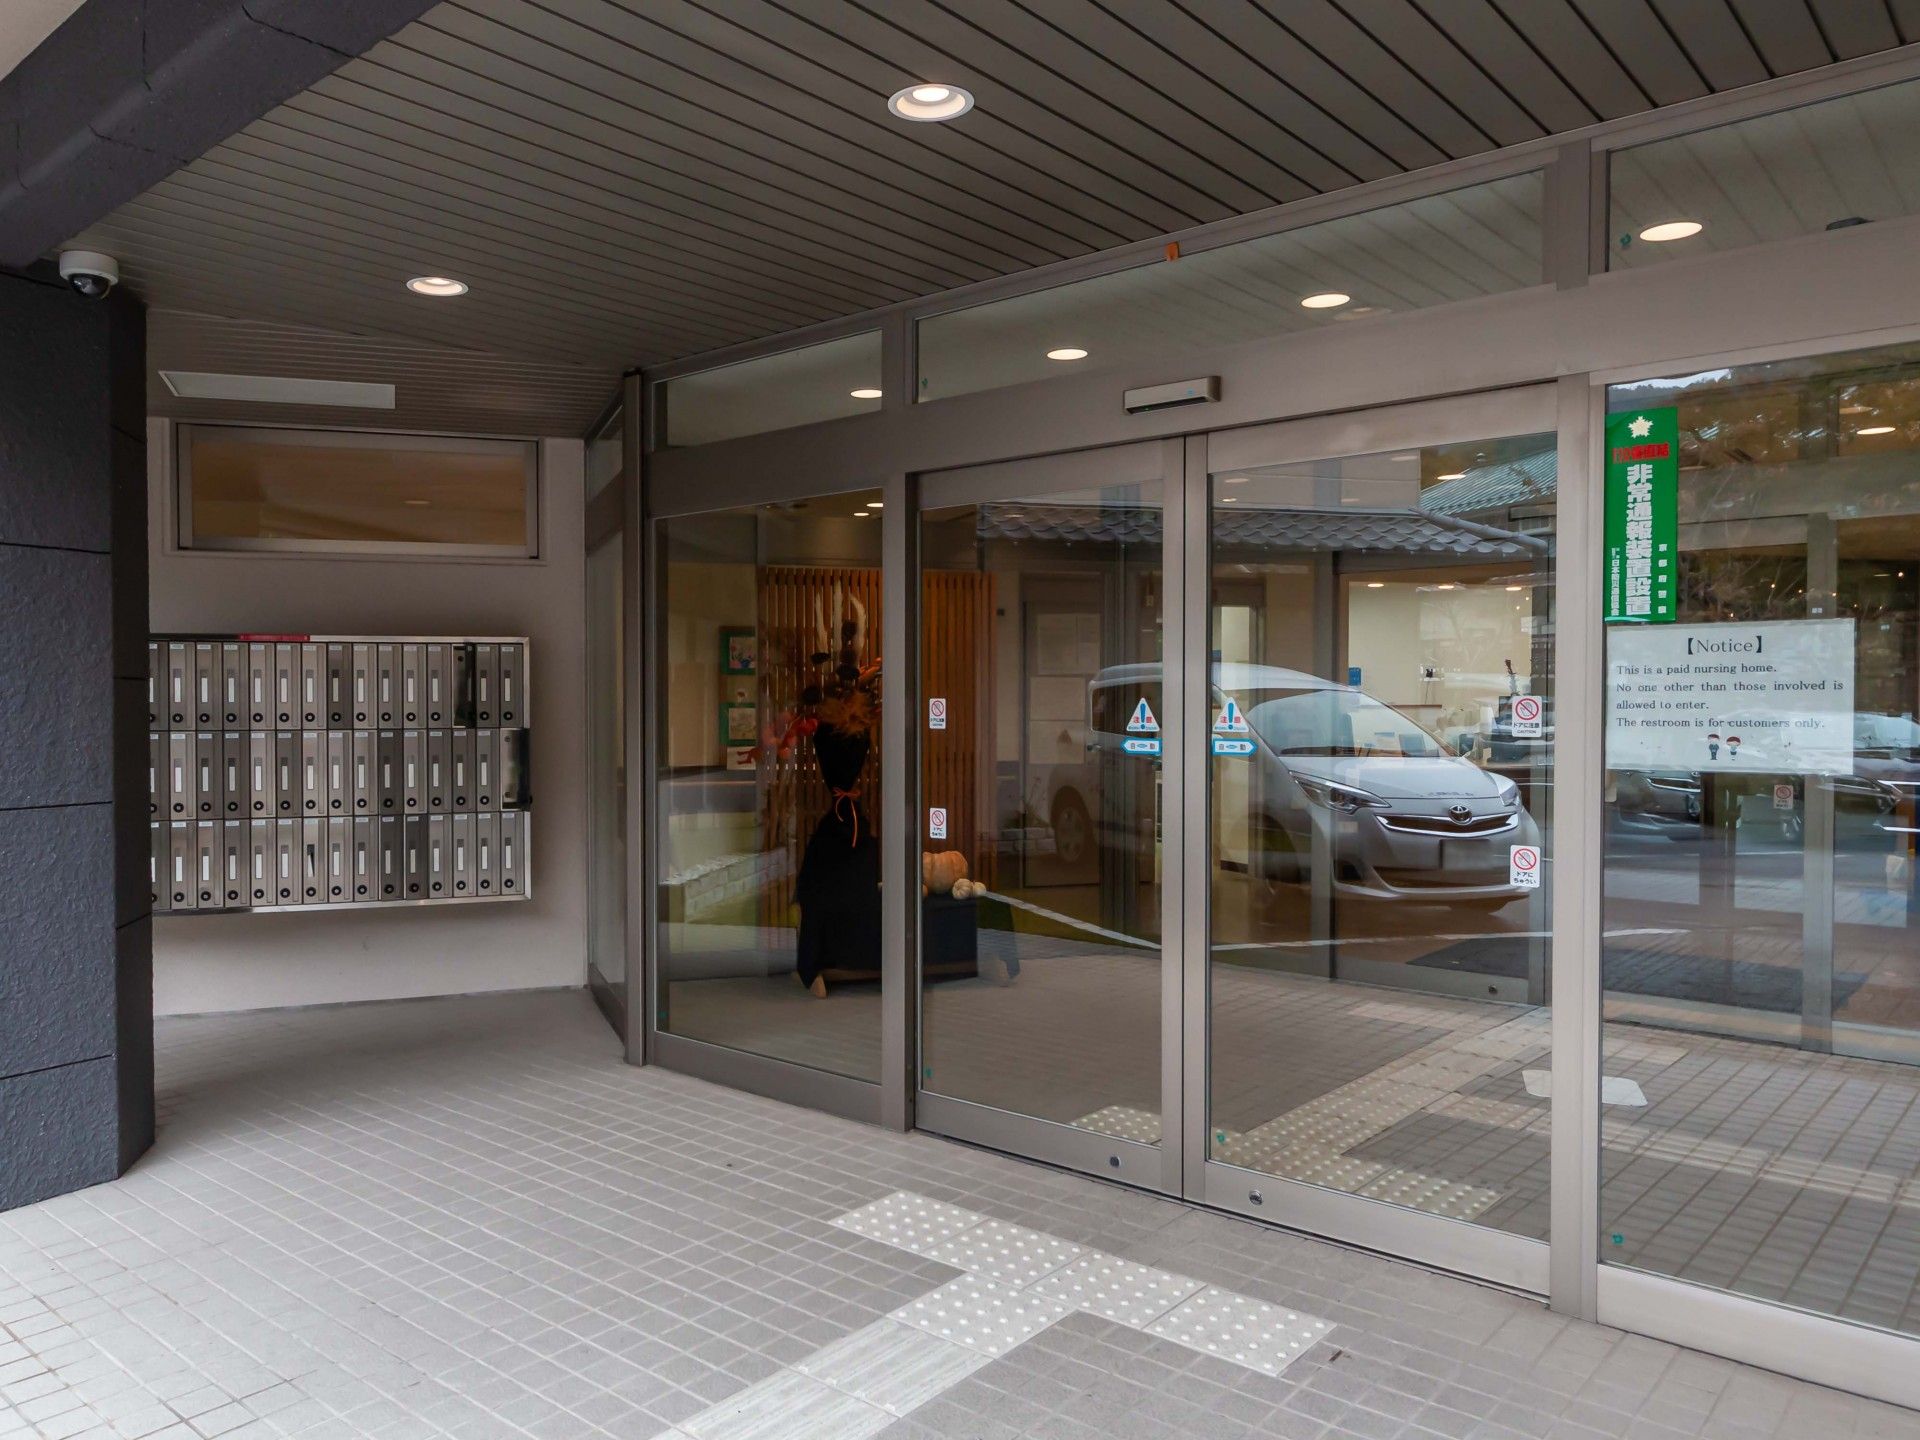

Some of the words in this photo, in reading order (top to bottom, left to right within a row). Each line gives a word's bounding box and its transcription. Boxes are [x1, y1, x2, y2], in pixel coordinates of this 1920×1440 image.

[1626, 464, 1653, 615] 非常通報装置設置
[1616, 665, 1640, 675] This
[1643, 665, 1653, 674] is
[1666, 664, 1690, 675] paid
[1694, 663, 1737, 674] nursing
[1741, 663, 1777, 673] home.
[1616, 683, 1632, 692] No
[1638, 684, 1658, 692] one
[1664, 682, 1694, 692] other
[1701, 682, 1727, 691] than
[1733, 681, 1767, 691] those
[1774, 680, 1826, 691] involved
[1833, 680, 1844, 690] is
[1616, 700, 1656, 710] allowed
[1660, 701, 1672, 710] to
[1675, 701, 1709, 710] enter.
[1616, 717, 1637, 727] The
[1641, 718, 1691, 727] restroom
[1695, 718, 1704, 727] is
[1708, 718, 1725, 727] for
[1728, 718, 1790, 728] customers
[1794, 718, 1825, 730] only.
